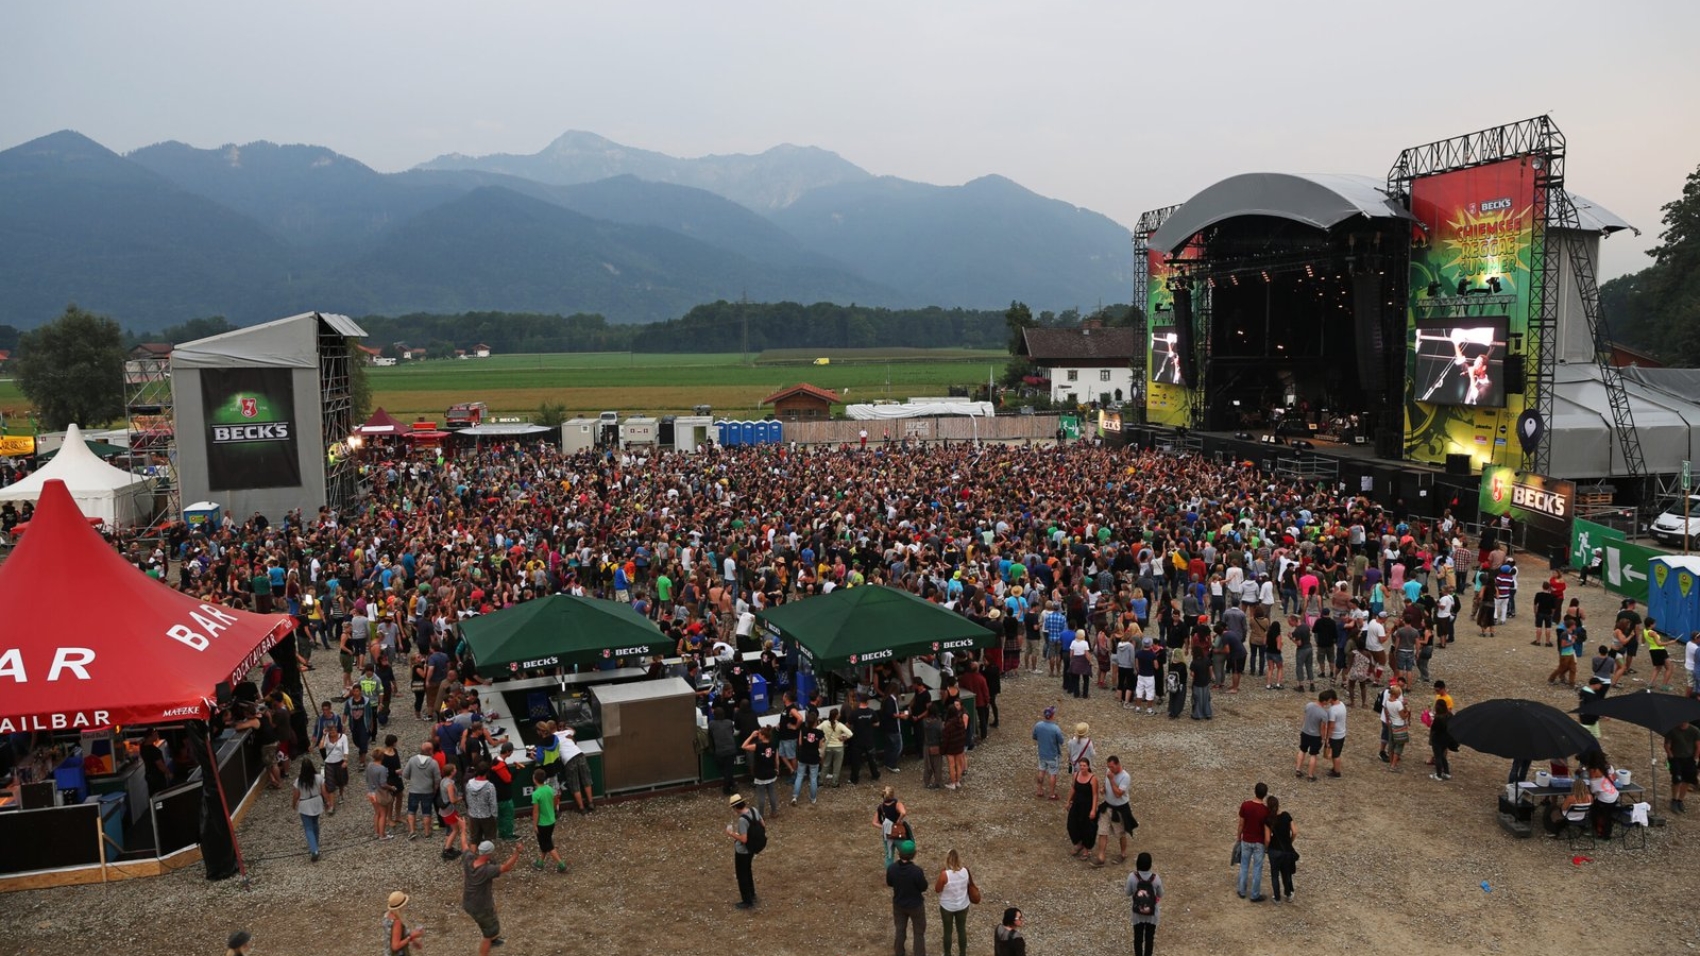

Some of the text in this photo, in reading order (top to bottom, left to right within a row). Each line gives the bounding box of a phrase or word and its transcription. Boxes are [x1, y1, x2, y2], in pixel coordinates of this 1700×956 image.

[1481, 199, 1511, 211] BECK'S
[1455, 218, 1522, 242] CHIEMSEE
[1461, 236, 1516, 259] REGGAE
[1458, 255, 1517, 277] SUMMER
[214, 423, 288, 441] BECK'S
[1512, 484, 1566, 516] BECK'S
[165, 603, 239, 652] BAR
[615, 645, 649, 656] BECK'S
[942, 638, 974, 649] BECK'S
[232, 632, 278, 686] COCKTAILBAR
[523, 656, 559, 669] BECK'S
[861, 649, 893, 662] BECK'S
[0, 710, 111, 734] AILBAR
